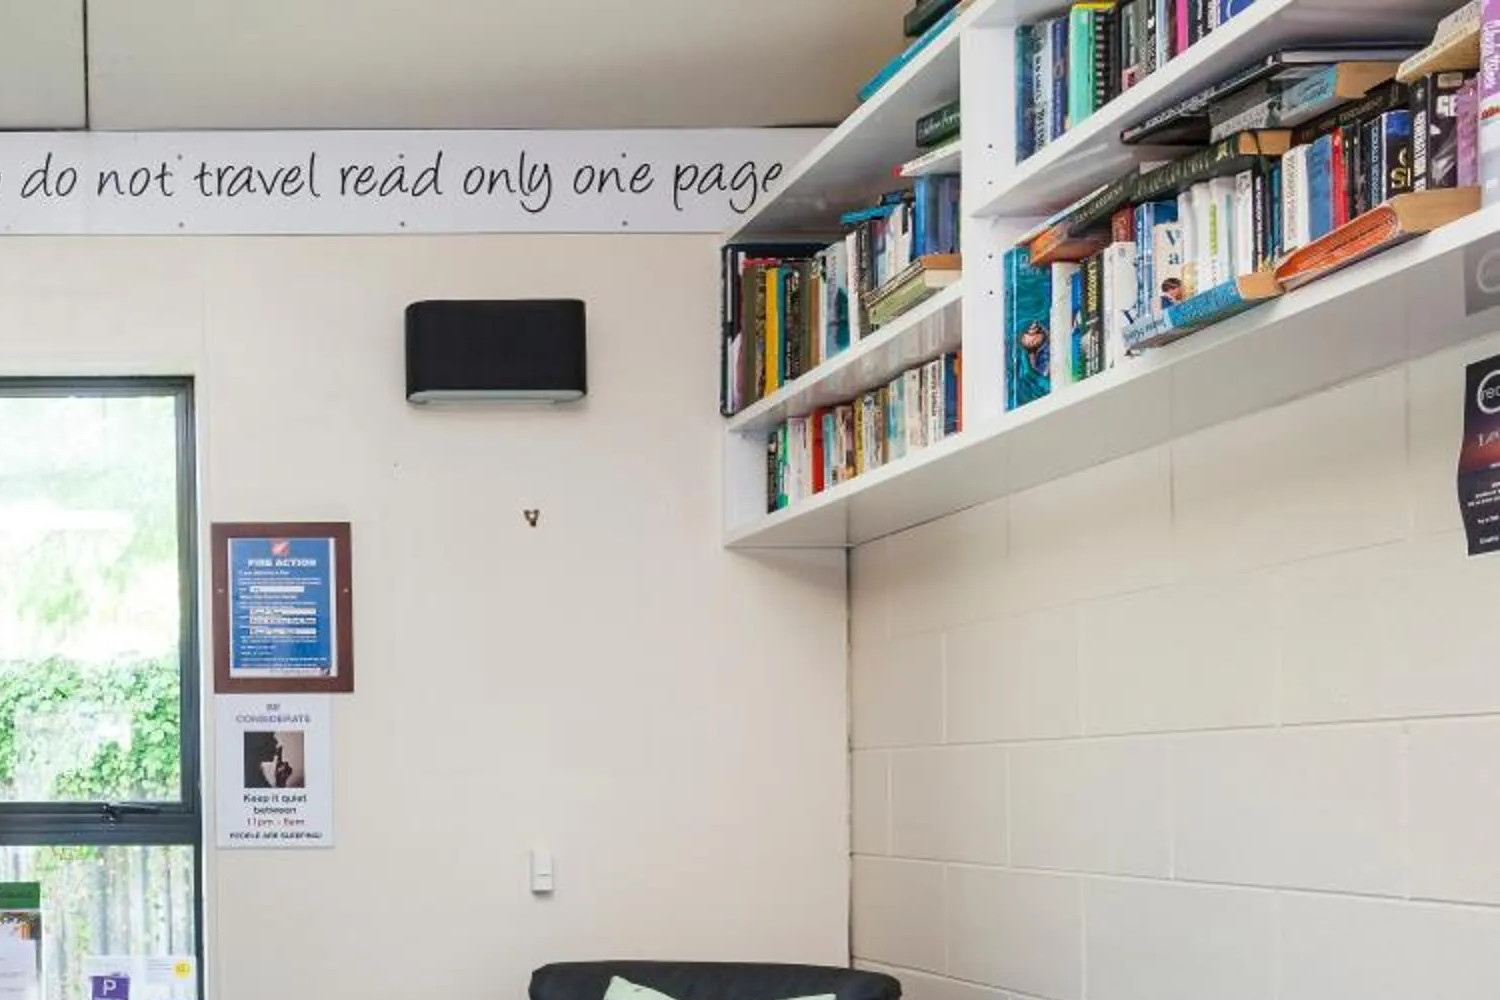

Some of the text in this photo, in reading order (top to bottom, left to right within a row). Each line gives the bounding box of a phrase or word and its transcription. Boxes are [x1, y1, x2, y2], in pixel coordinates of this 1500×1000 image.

[19, 151, 78, 199] do
[96, 161, 175, 198] not
[192, 151, 321, 199] travel
[339, 149, 444, 198] read
[462, 149, 553, 215] only
[572, 162, 655, 196] one
[673, 160, 784, 215] page
[275, 558, 318, 568] ACTION
[243, 794, 270, 804] Keep
[281, 794, 308, 805] quiet
[253, 806, 298, 815] between
